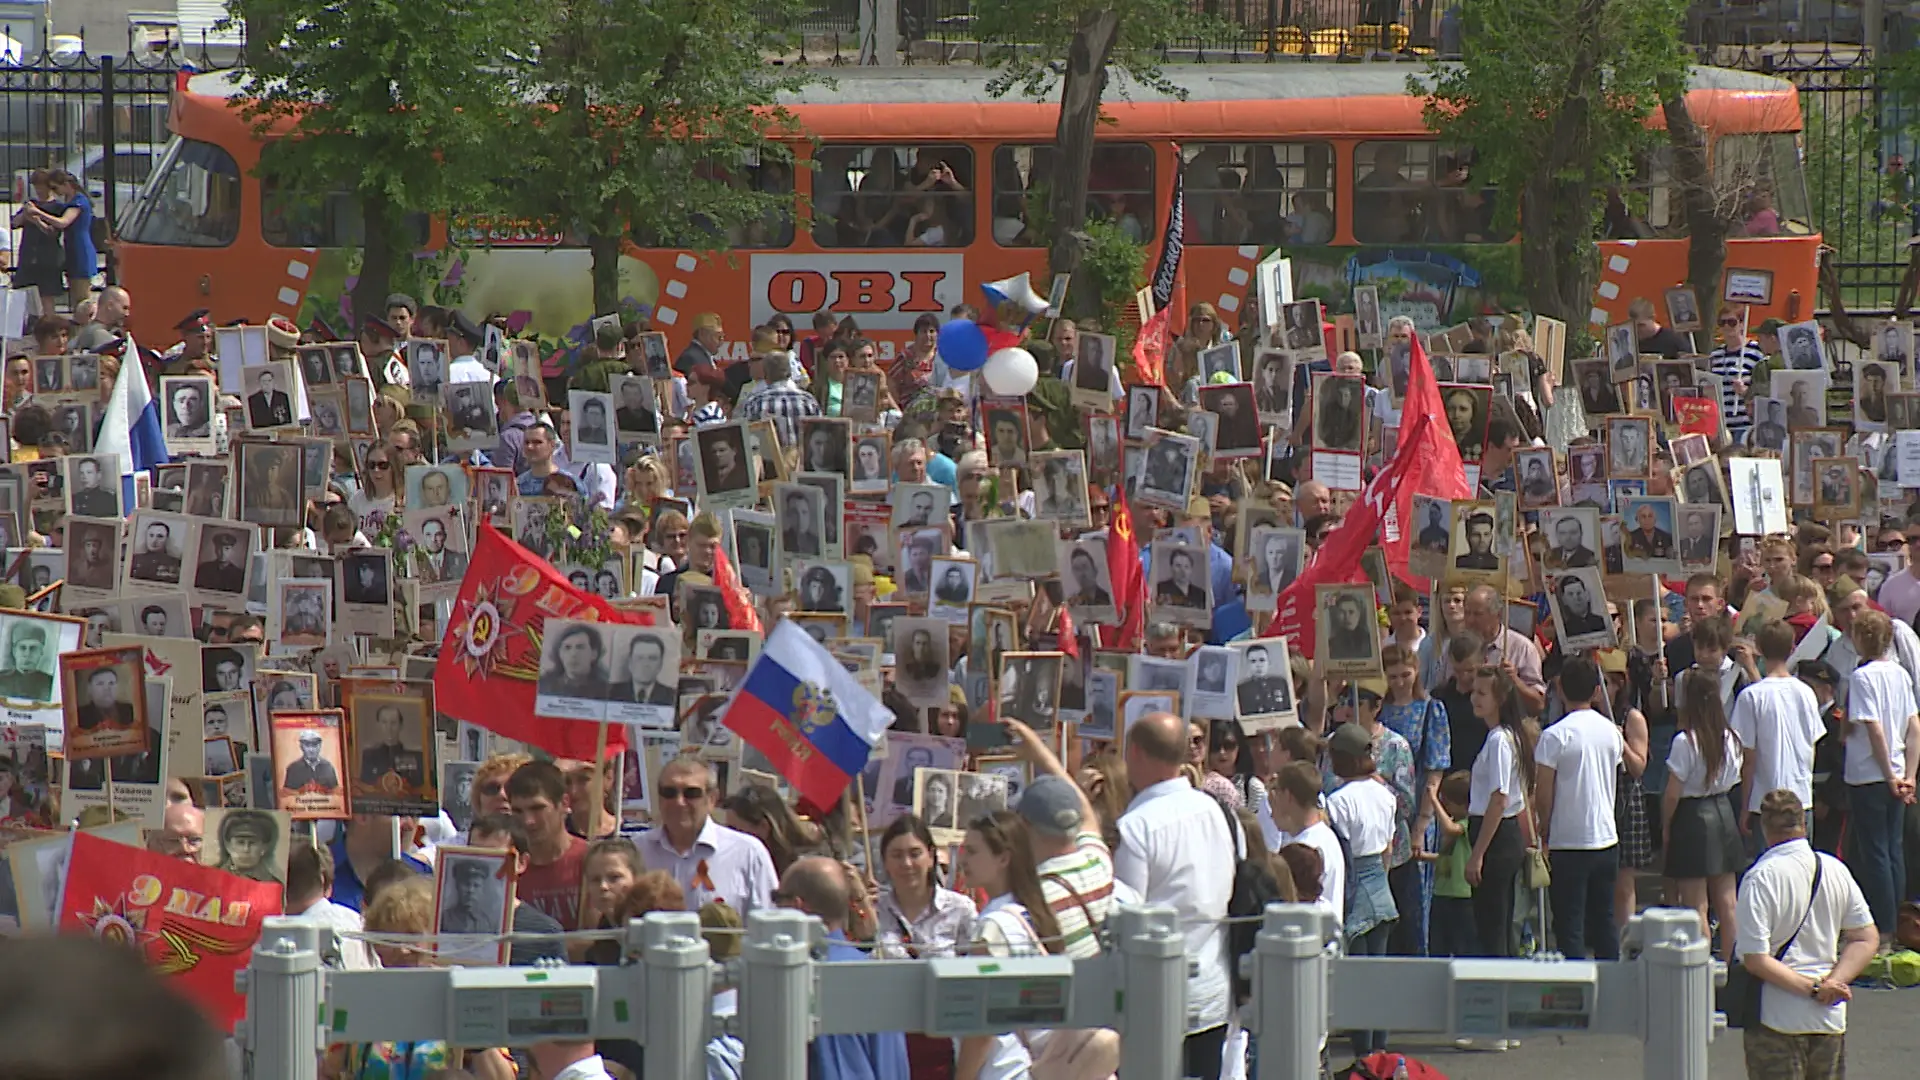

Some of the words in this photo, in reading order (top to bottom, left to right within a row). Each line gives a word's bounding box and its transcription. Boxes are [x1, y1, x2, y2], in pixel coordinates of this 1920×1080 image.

[767, 269, 947, 314] OBI
[502, 563, 541, 597] 9
[127, 874, 163, 906] 9
[163, 887, 251, 927] МАЯ
